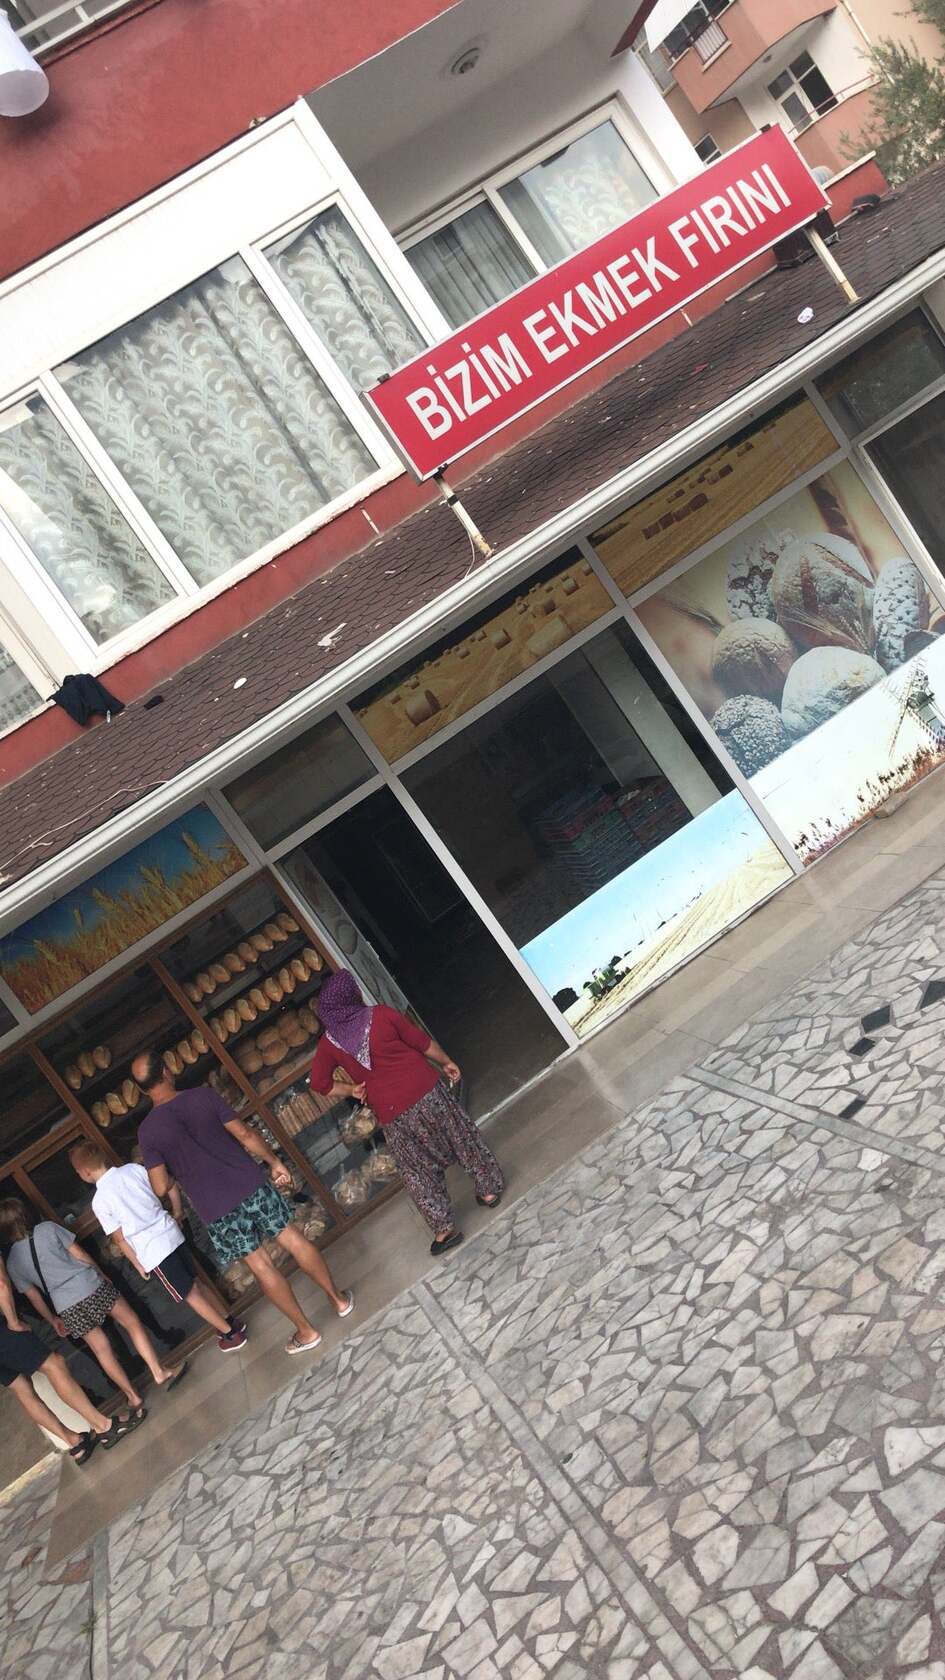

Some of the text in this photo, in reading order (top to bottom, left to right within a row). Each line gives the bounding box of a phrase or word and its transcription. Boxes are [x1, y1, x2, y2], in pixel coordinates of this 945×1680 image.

[406, 163, 792, 440] BİZİM EKMEK FIRINI
